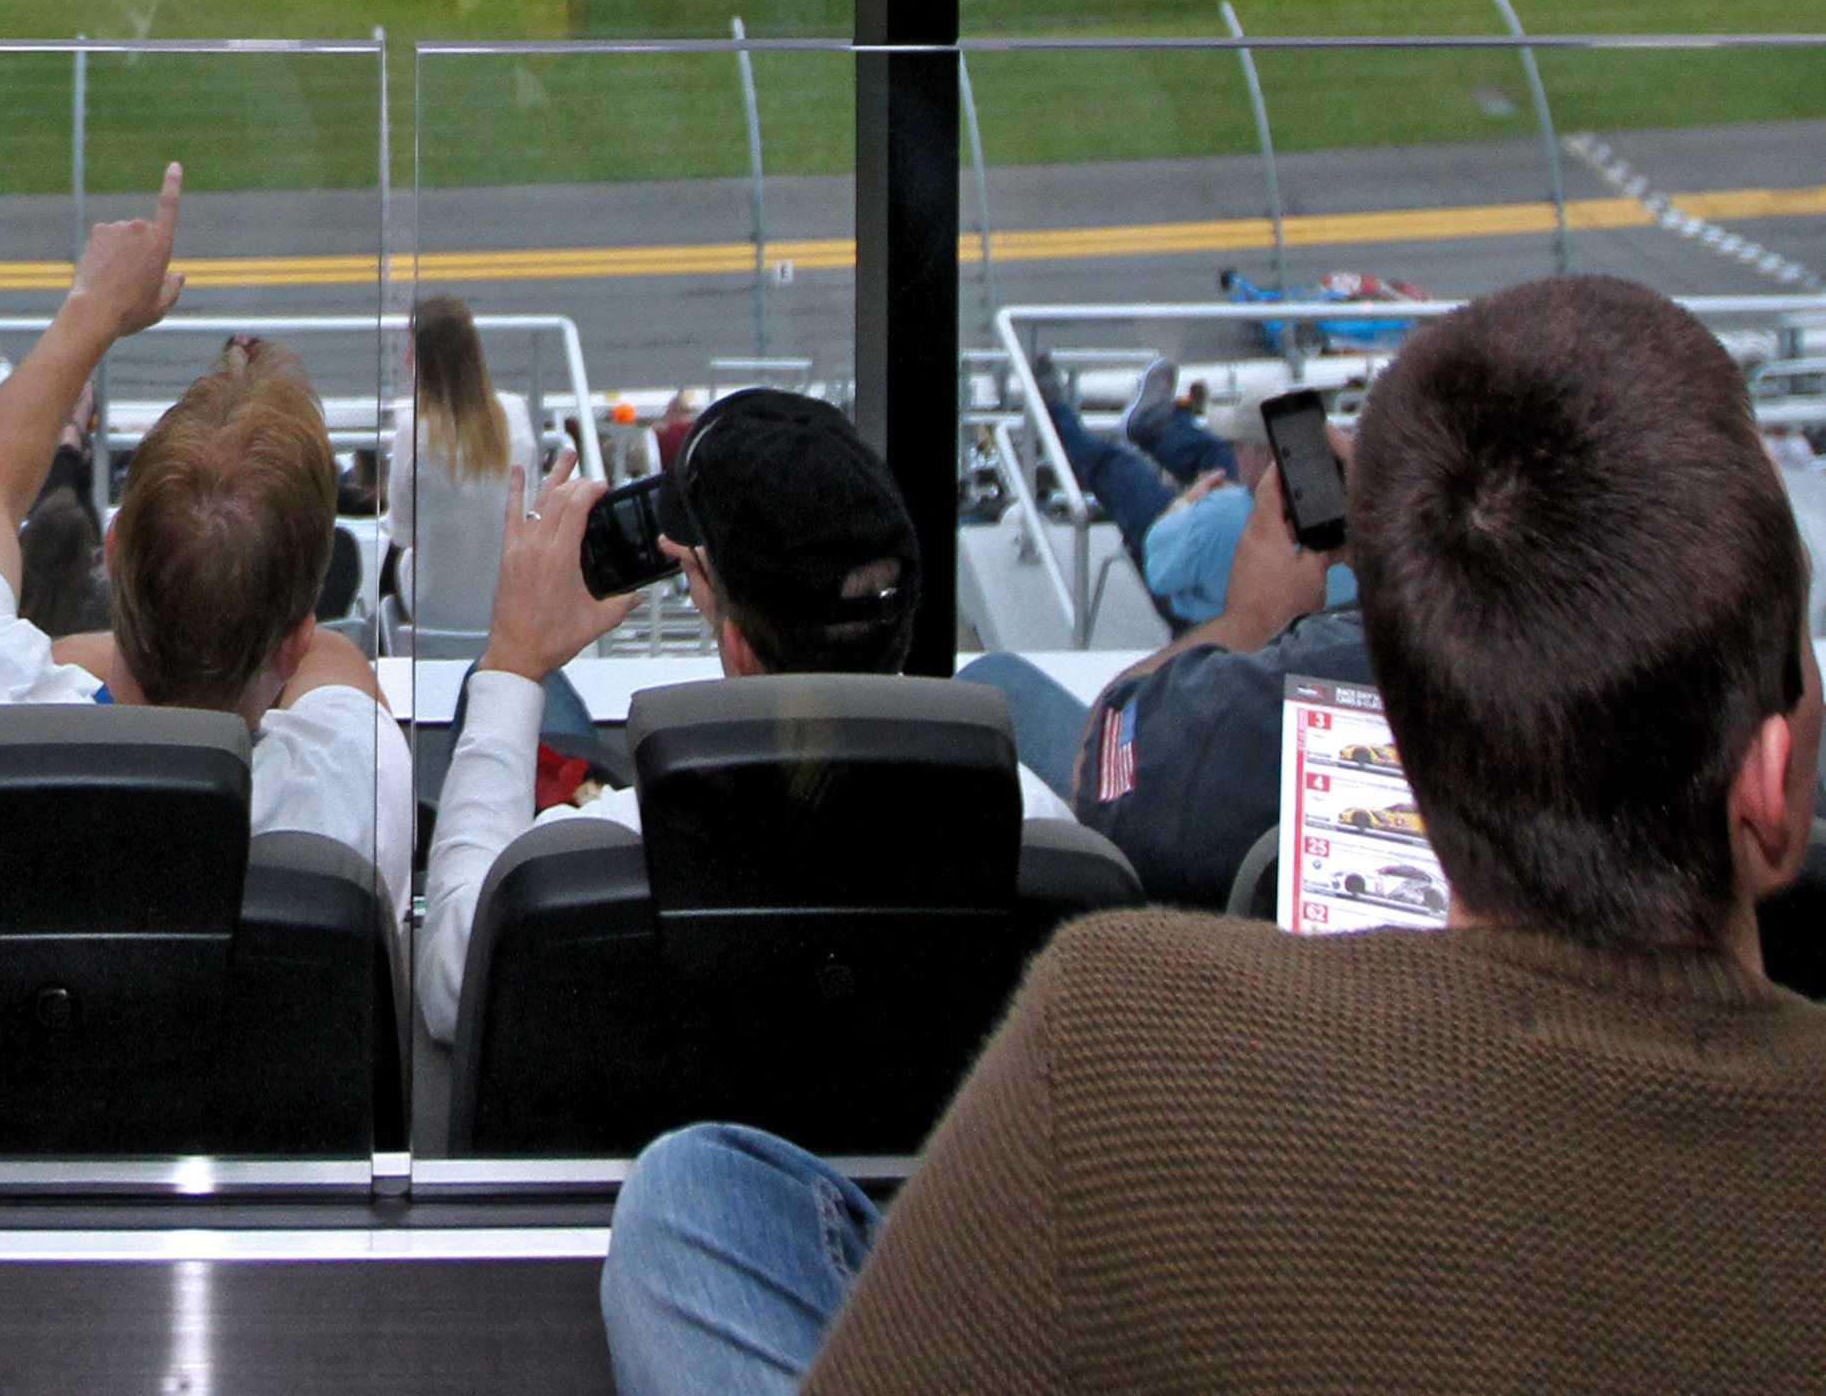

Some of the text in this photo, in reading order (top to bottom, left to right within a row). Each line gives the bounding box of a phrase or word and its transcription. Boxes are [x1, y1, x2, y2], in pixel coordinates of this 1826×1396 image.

[1314, 712, 1326, 728] 3
[1314, 776, 1325, 790] 4
[1309, 838, 1328, 857] 25
[1307, 904, 1327, 923] 62
